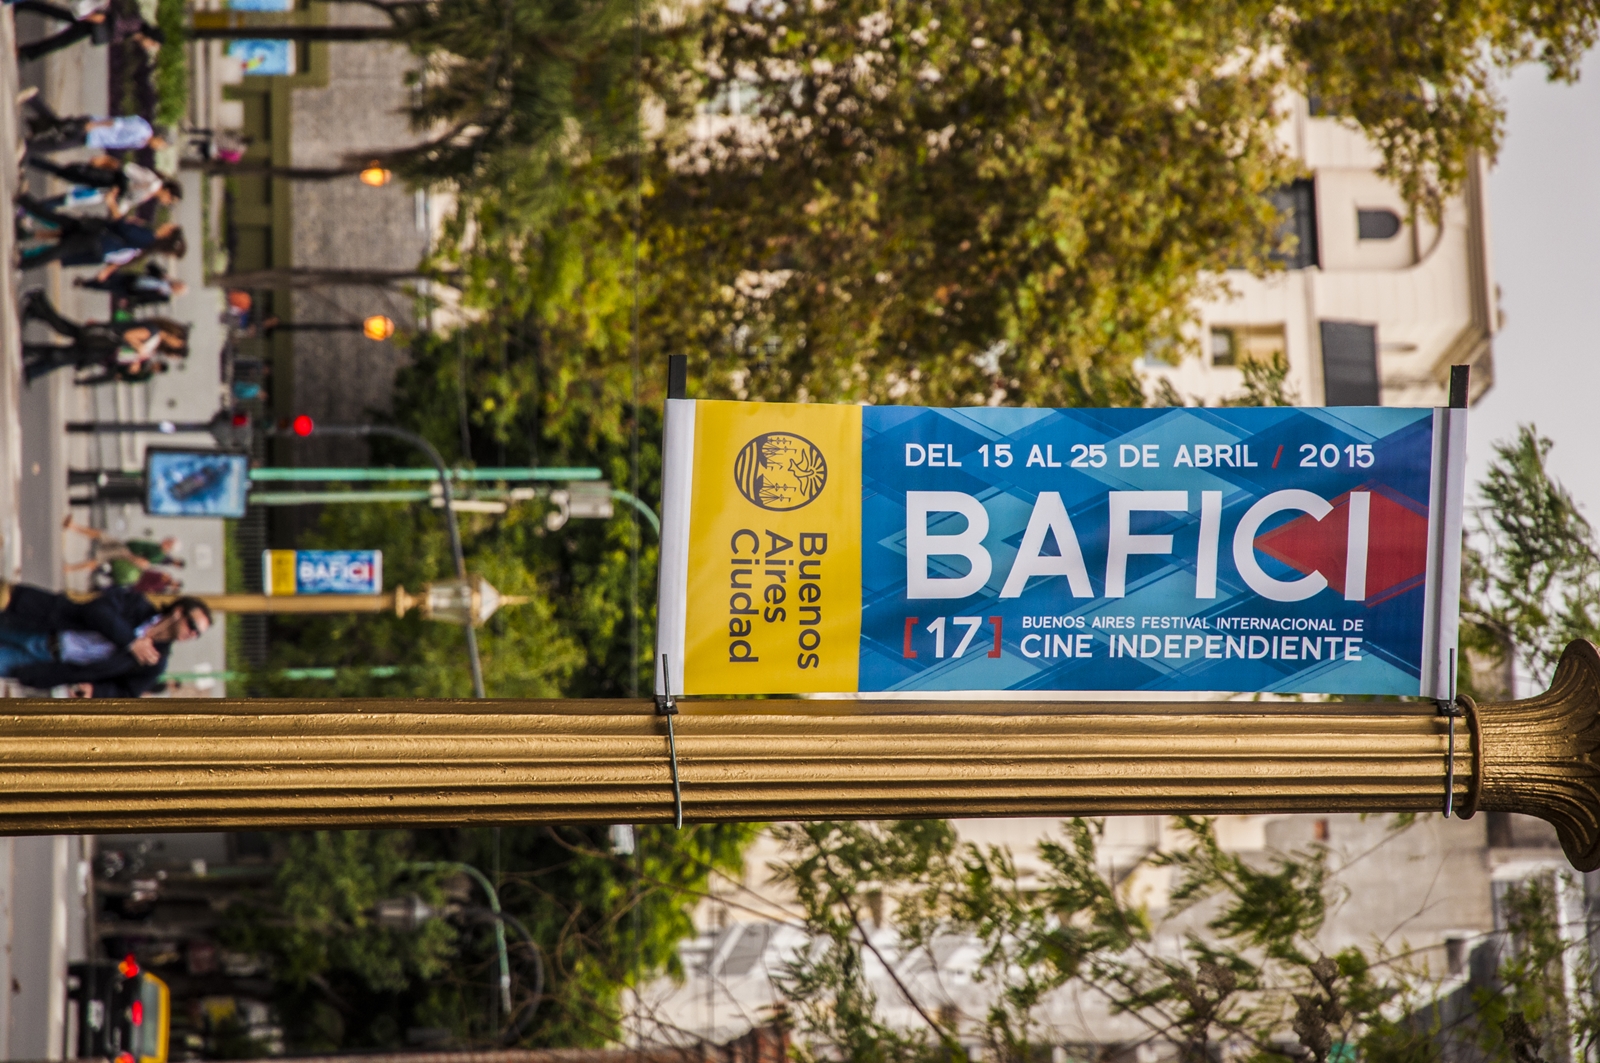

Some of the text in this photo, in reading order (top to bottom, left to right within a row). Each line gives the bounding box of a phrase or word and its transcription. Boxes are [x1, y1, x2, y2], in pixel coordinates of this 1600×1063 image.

[905, 443, 962, 468] DEL
[978, 444, 1015, 468] 15
[1025, 444, 1061, 468] AL
[1070, 444, 1108, 469] 25
[1120, 444, 1160, 469] DE
[1173, 444, 1258, 469] ABRIL
[1299, 443, 1374, 469] 2015
[764, 530, 793, 623] Aires
[906, 490, 1370, 602] BAFICI
[729, 529, 760, 662] Ciudad
[798, 533, 828, 669] Buenos
[1022, 616, 1364, 632] BUENOS AIRES FESTIVAL INTERNACIONAL DE
[1021, 633, 1363, 661] CINE INDEPENDIENTE
